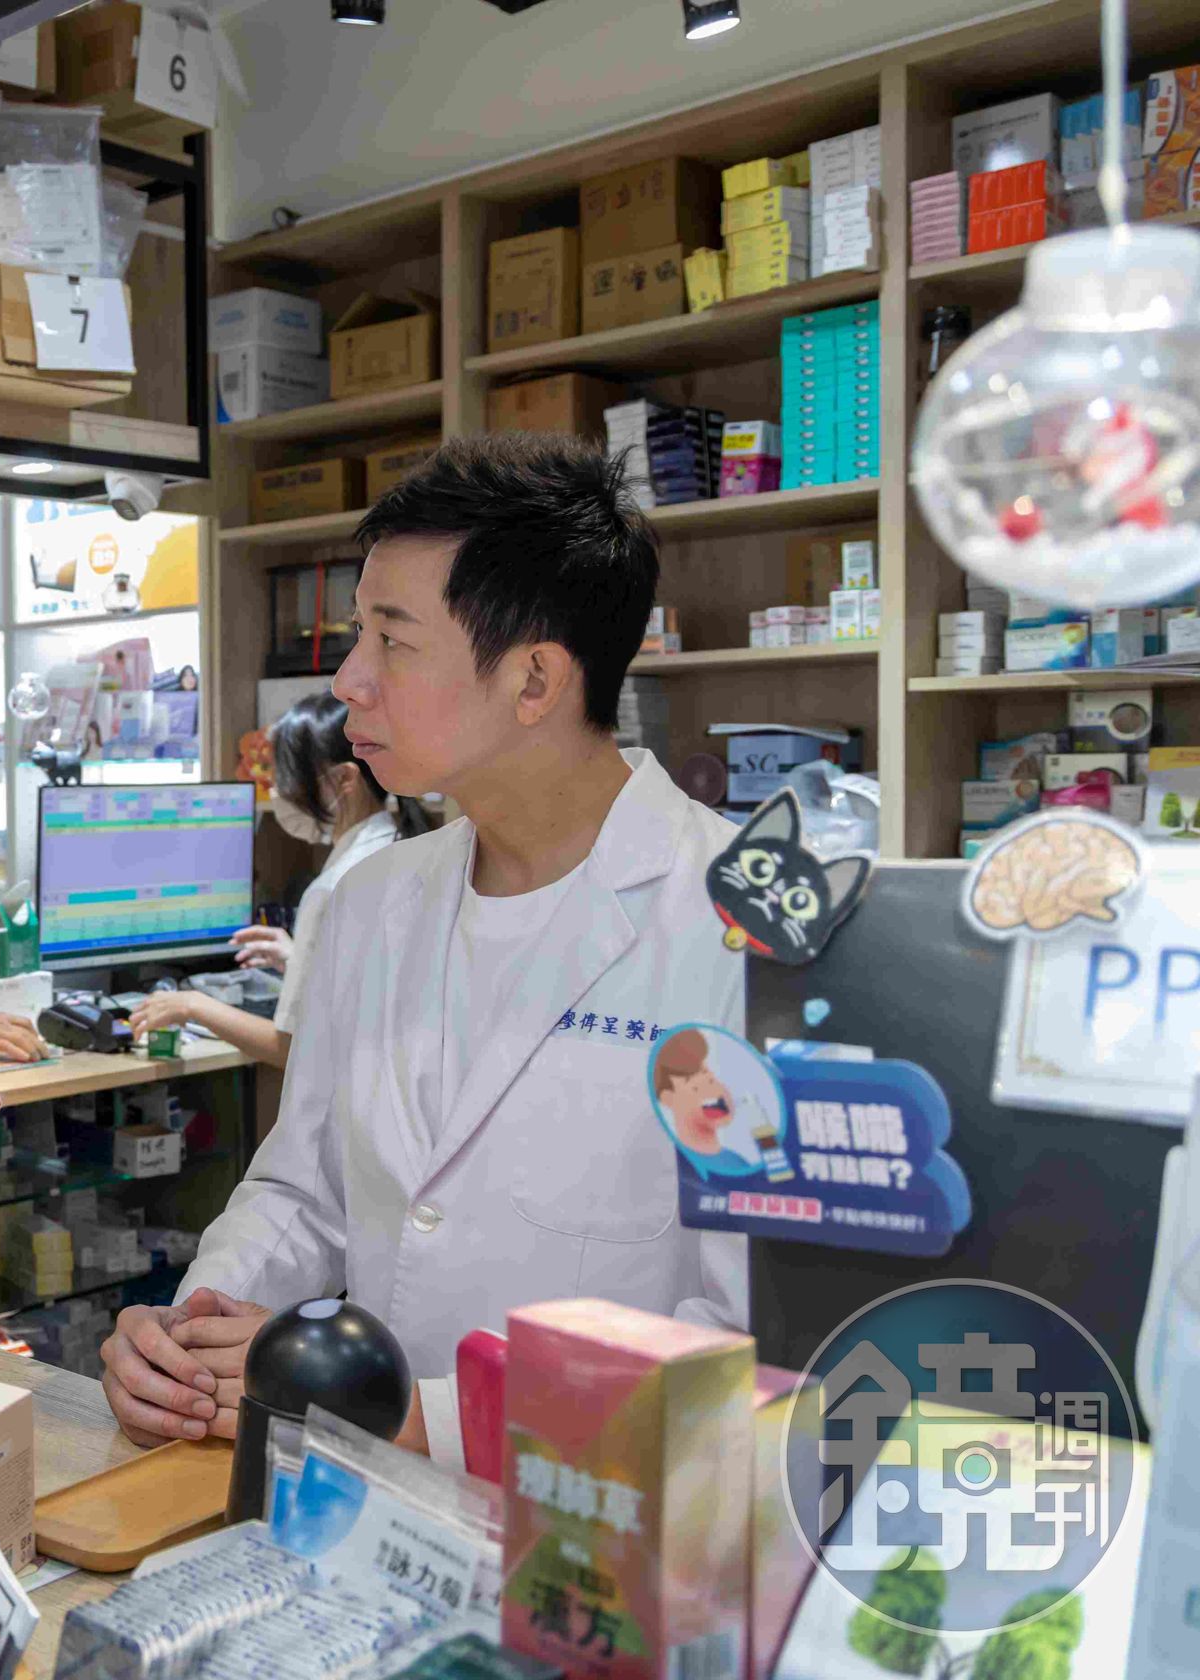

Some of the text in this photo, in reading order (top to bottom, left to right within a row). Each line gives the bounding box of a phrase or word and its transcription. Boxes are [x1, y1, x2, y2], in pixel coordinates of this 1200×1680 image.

[168, 54, 187, 91] 6
[69, 308, 89, 344] 7
[744, 751, 778, 774] SC
[794, 1099, 908, 1156] 喉嚨
[799, 1152, 914, 1191] 有點痛?
